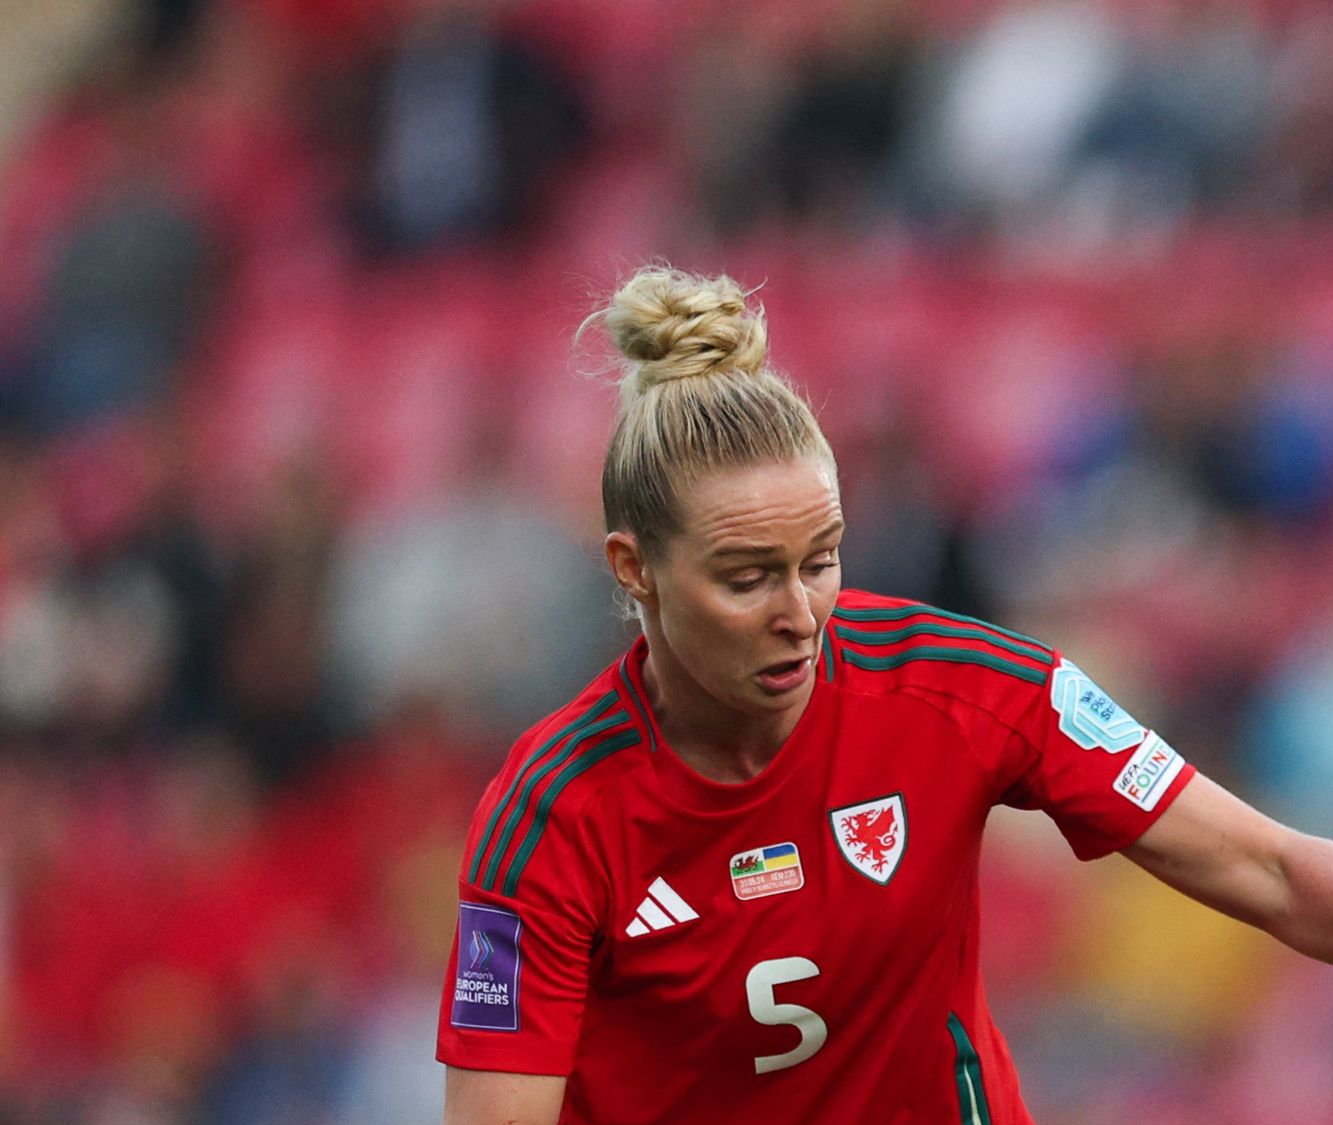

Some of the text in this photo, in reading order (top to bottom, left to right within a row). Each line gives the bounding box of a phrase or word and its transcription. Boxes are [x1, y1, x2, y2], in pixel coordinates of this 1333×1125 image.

[1118, 763, 1141, 791] UEFA
[456, 977, 508, 994] EUROPEAN
[455, 989, 510, 1006] QUALIFIERS
[745, 956, 828, 1075] 5
